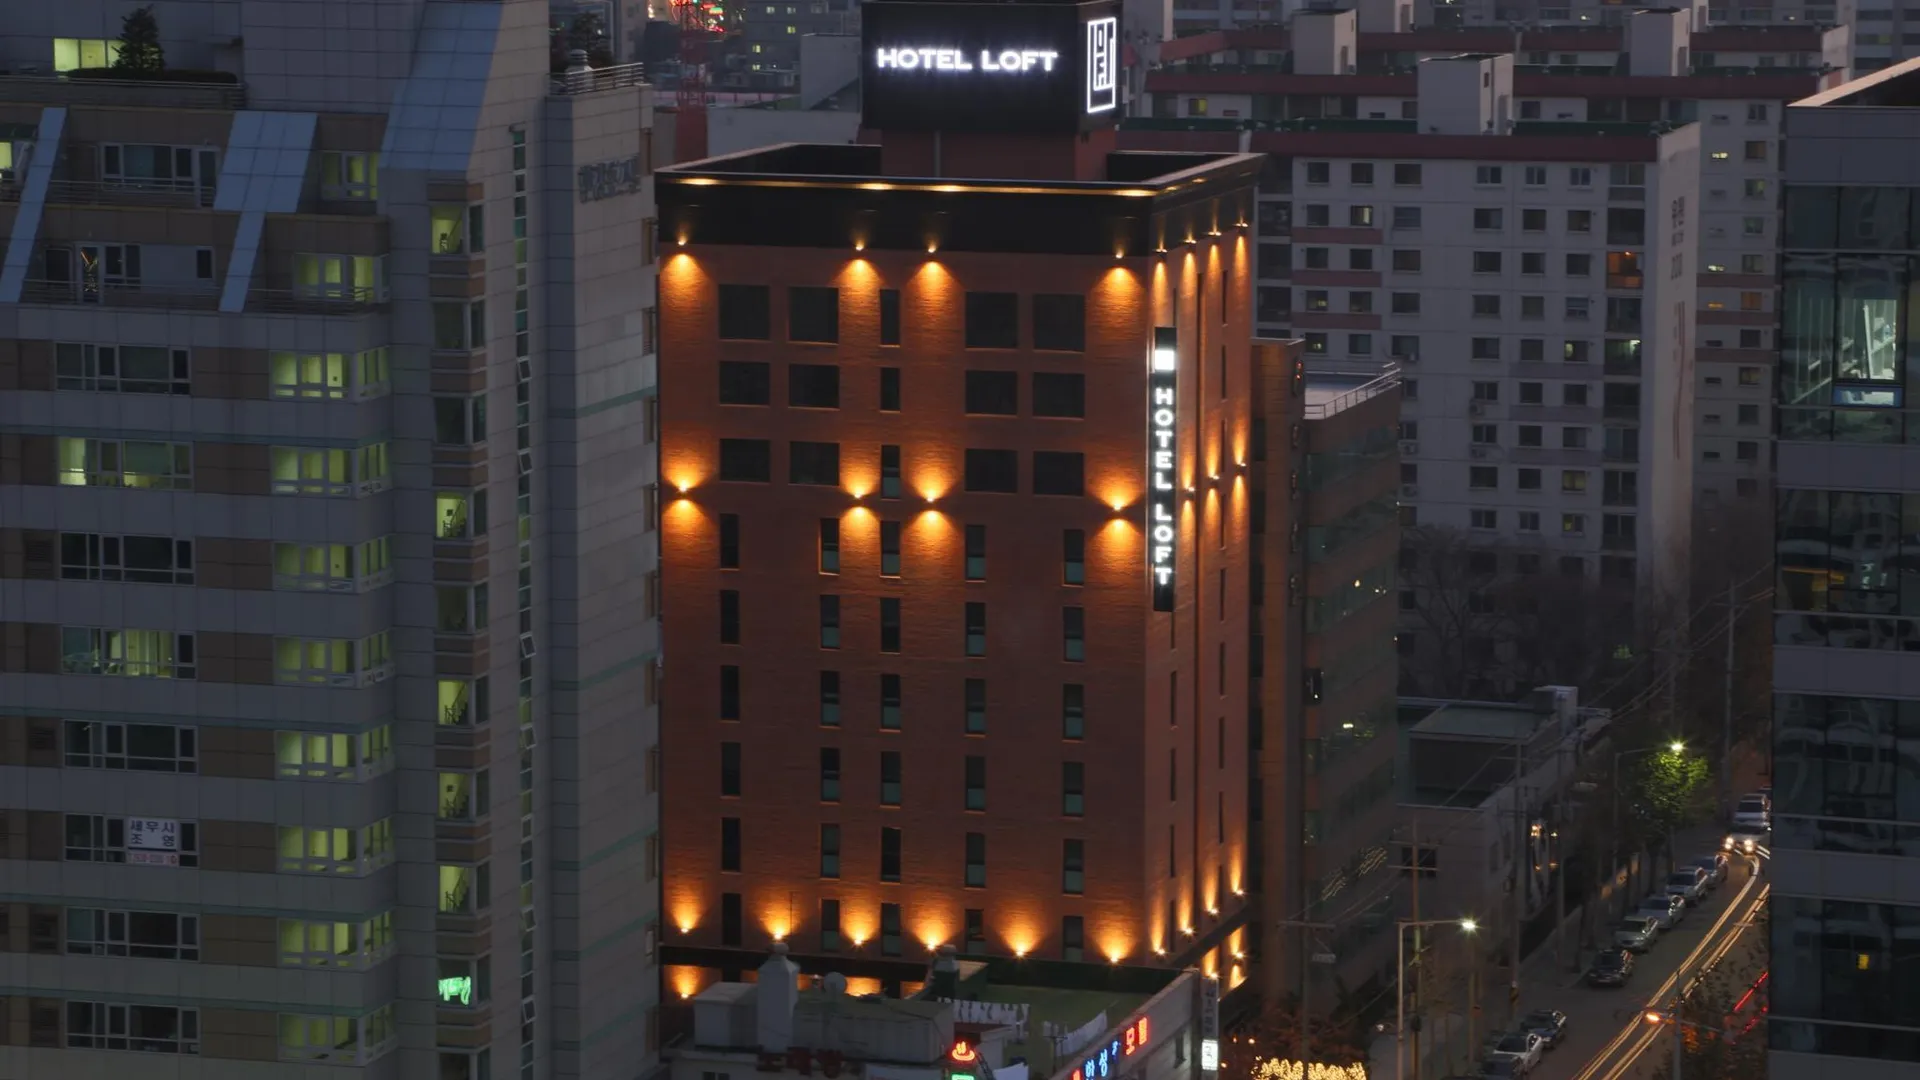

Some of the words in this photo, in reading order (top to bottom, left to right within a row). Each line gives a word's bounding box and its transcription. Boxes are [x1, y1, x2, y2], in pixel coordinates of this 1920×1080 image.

[877, 48, 973, 71] HOTEL
[981, 50, 1058, 72] LOFT
[1154, 387, 1173, 491] HOTEL
[1154, 503, 1173, 586] LOFT
